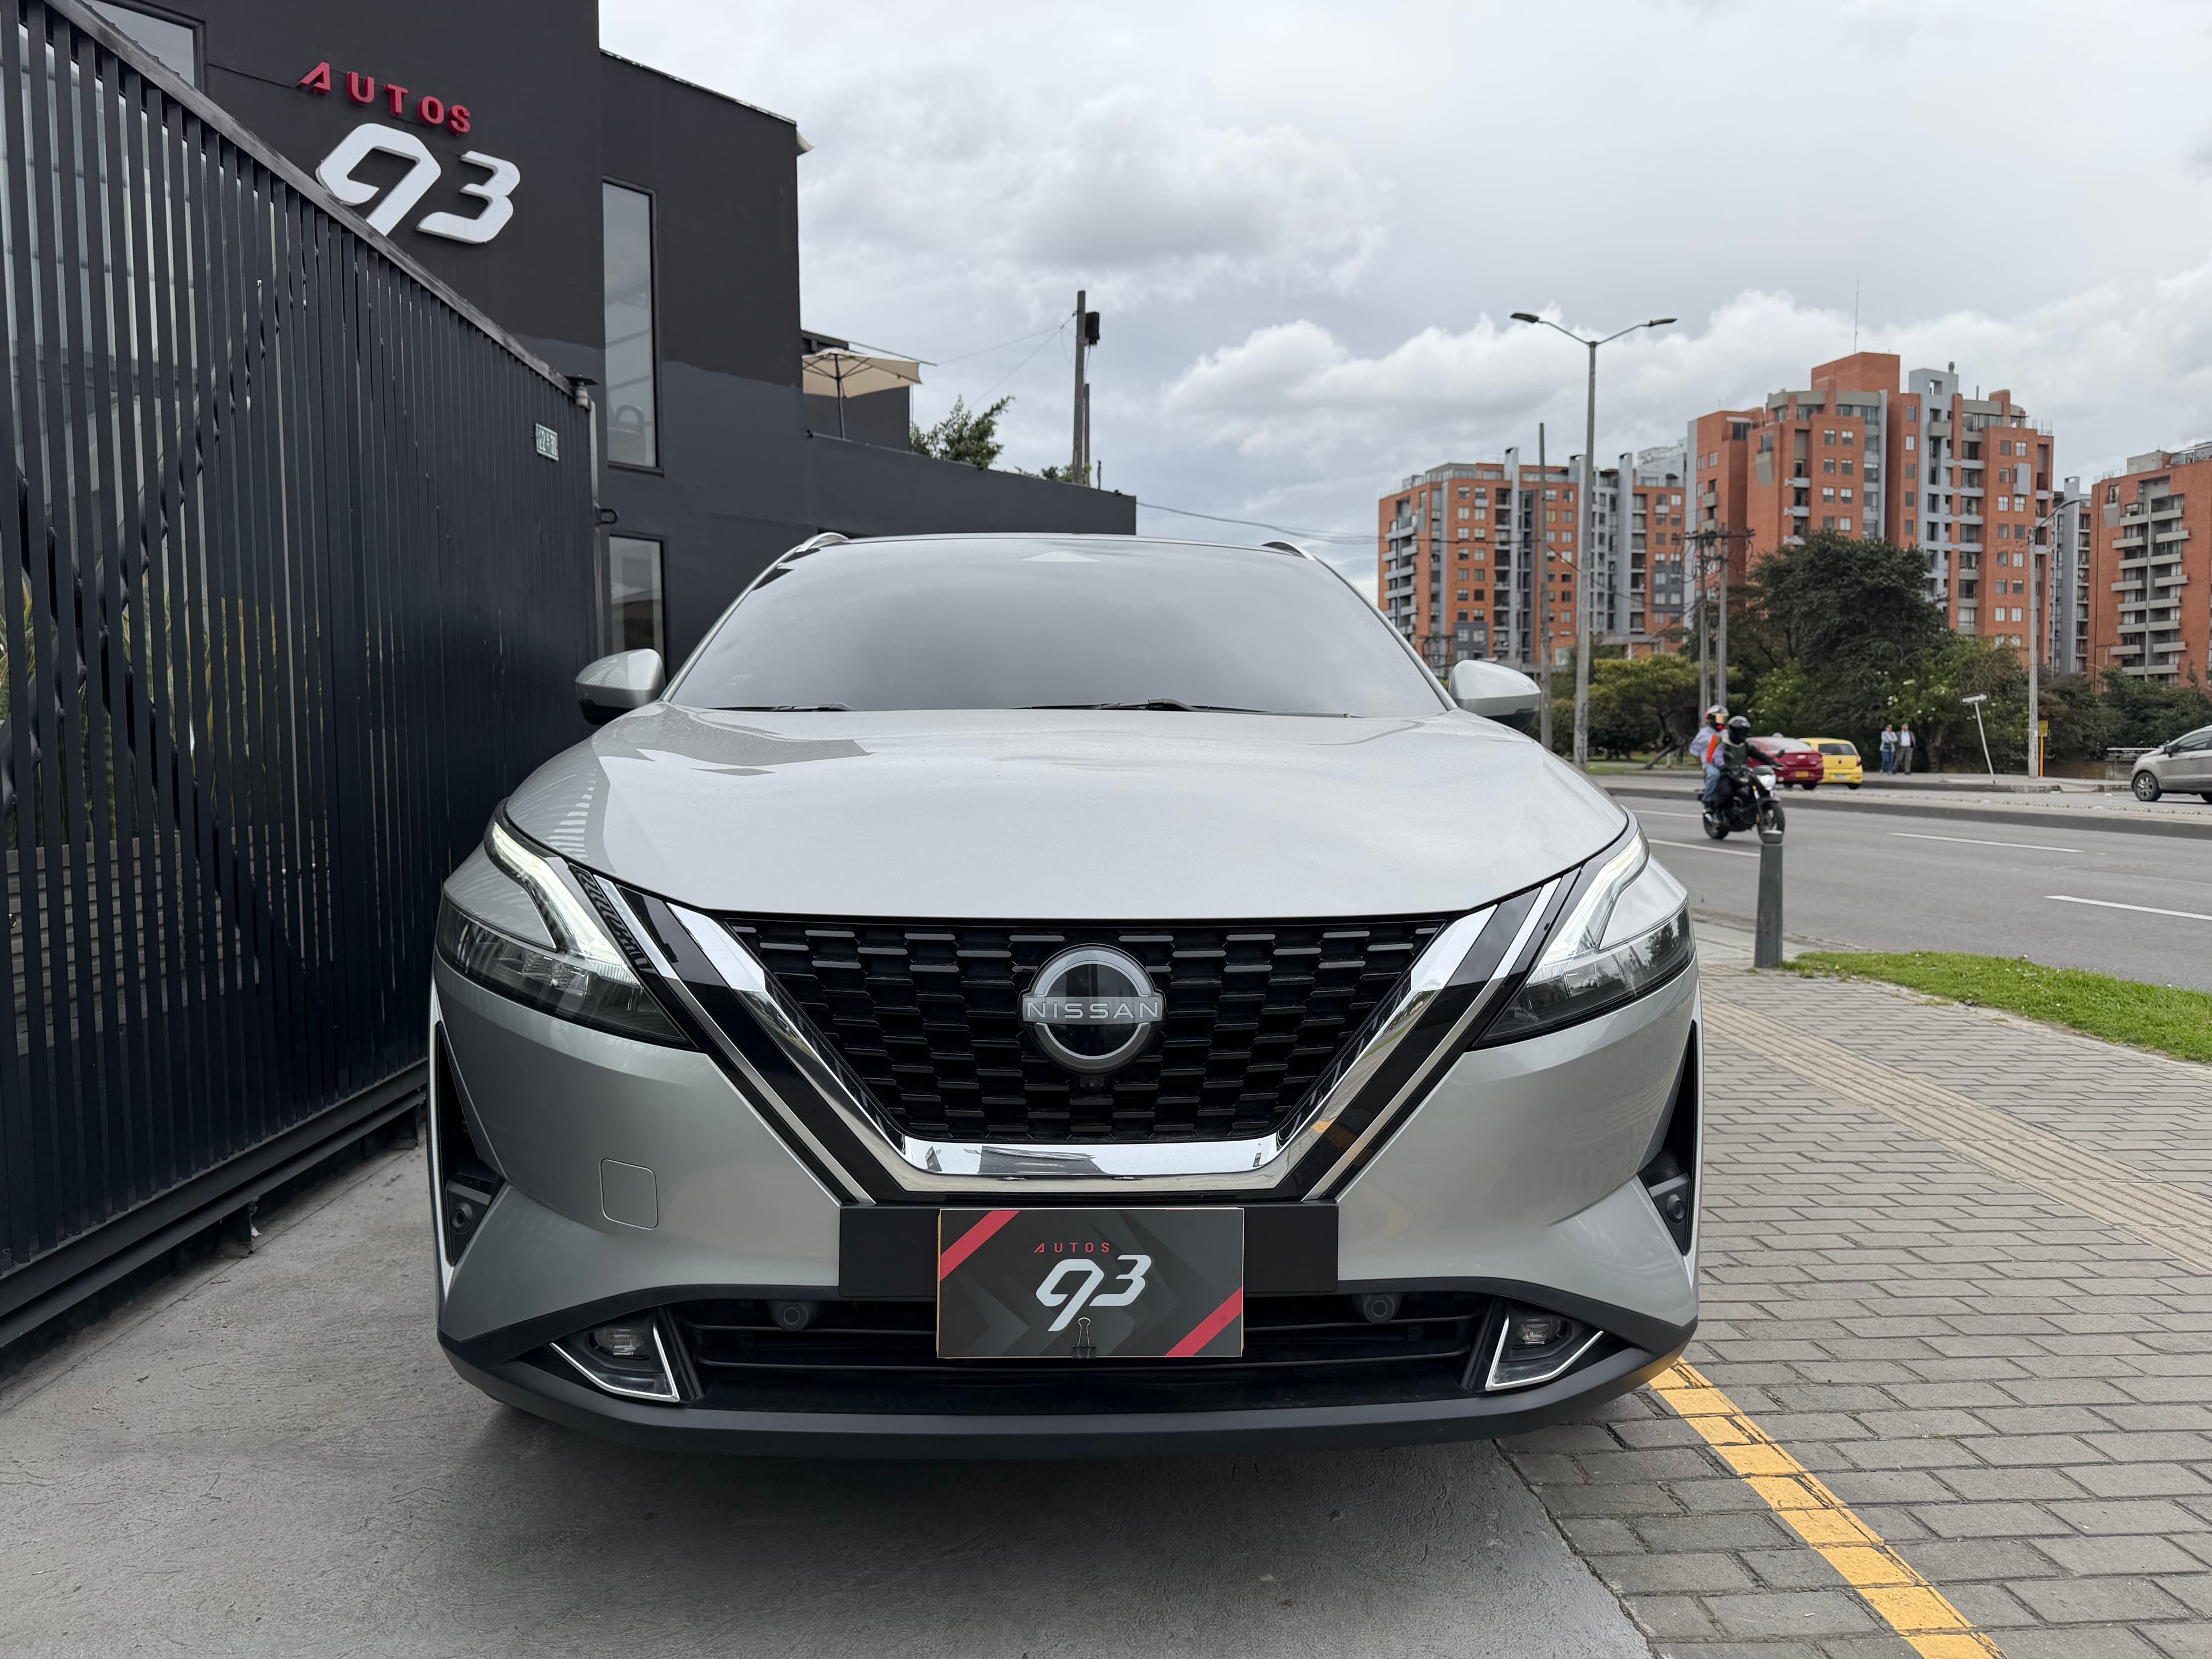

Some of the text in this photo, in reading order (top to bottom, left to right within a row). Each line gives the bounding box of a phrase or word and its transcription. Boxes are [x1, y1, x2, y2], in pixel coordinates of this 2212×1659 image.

[297, 62, 471, 134] AUTOS
[316, 123, 521, 244] 93
[1027, 1001, 1158, 1019] NISSAN
[1034, 1242, 1109, 1253] AUTOS
[1036, 1255, 1152, 1331] 93
